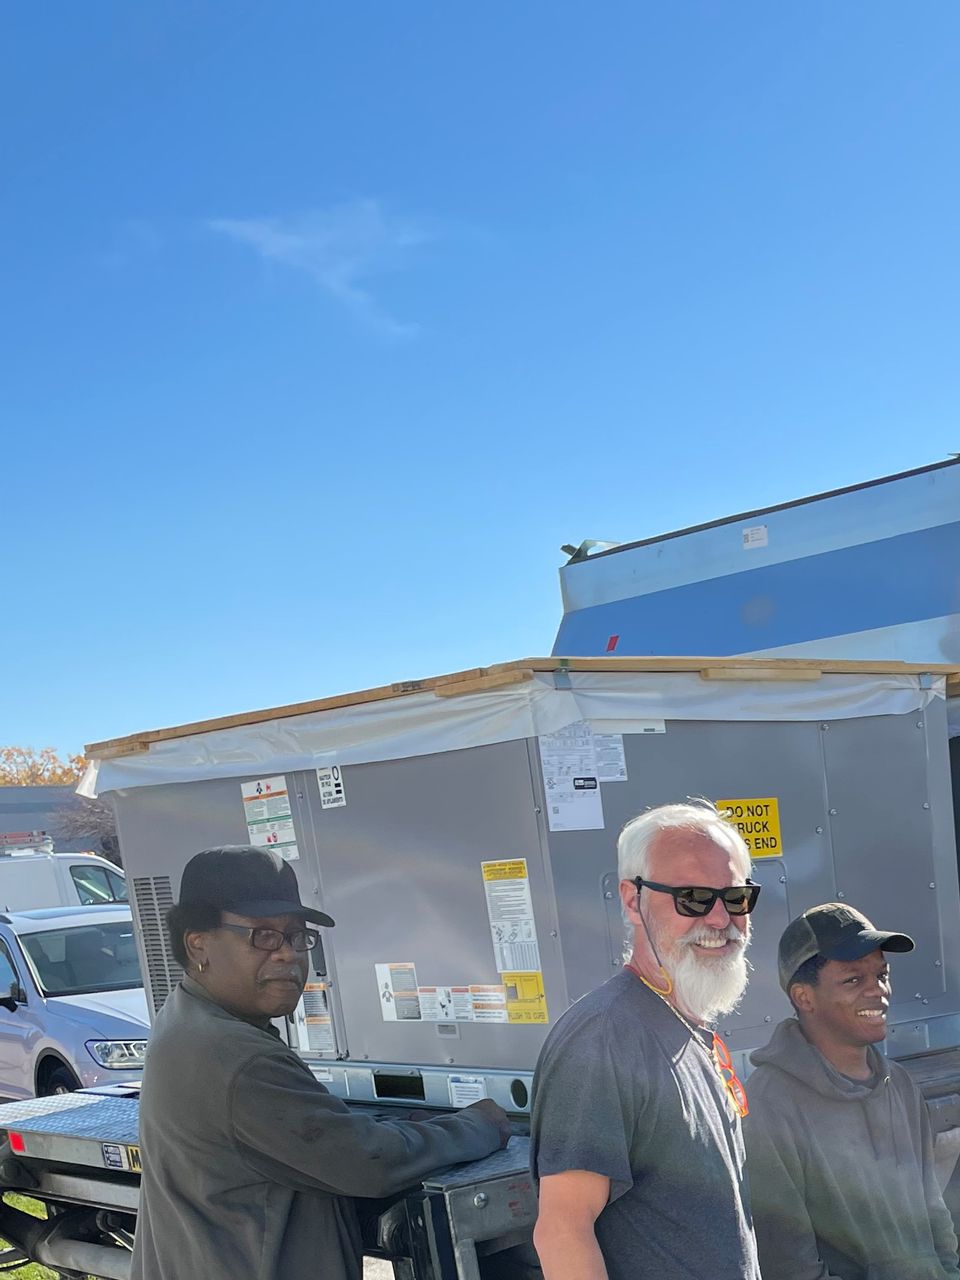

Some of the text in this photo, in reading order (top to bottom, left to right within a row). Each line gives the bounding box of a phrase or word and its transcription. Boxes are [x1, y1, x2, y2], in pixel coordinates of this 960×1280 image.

[726, 804, 770, 818] DO NOT
[737, 821, 770, 834] RUCK
[754, 836, 778, 850] END
